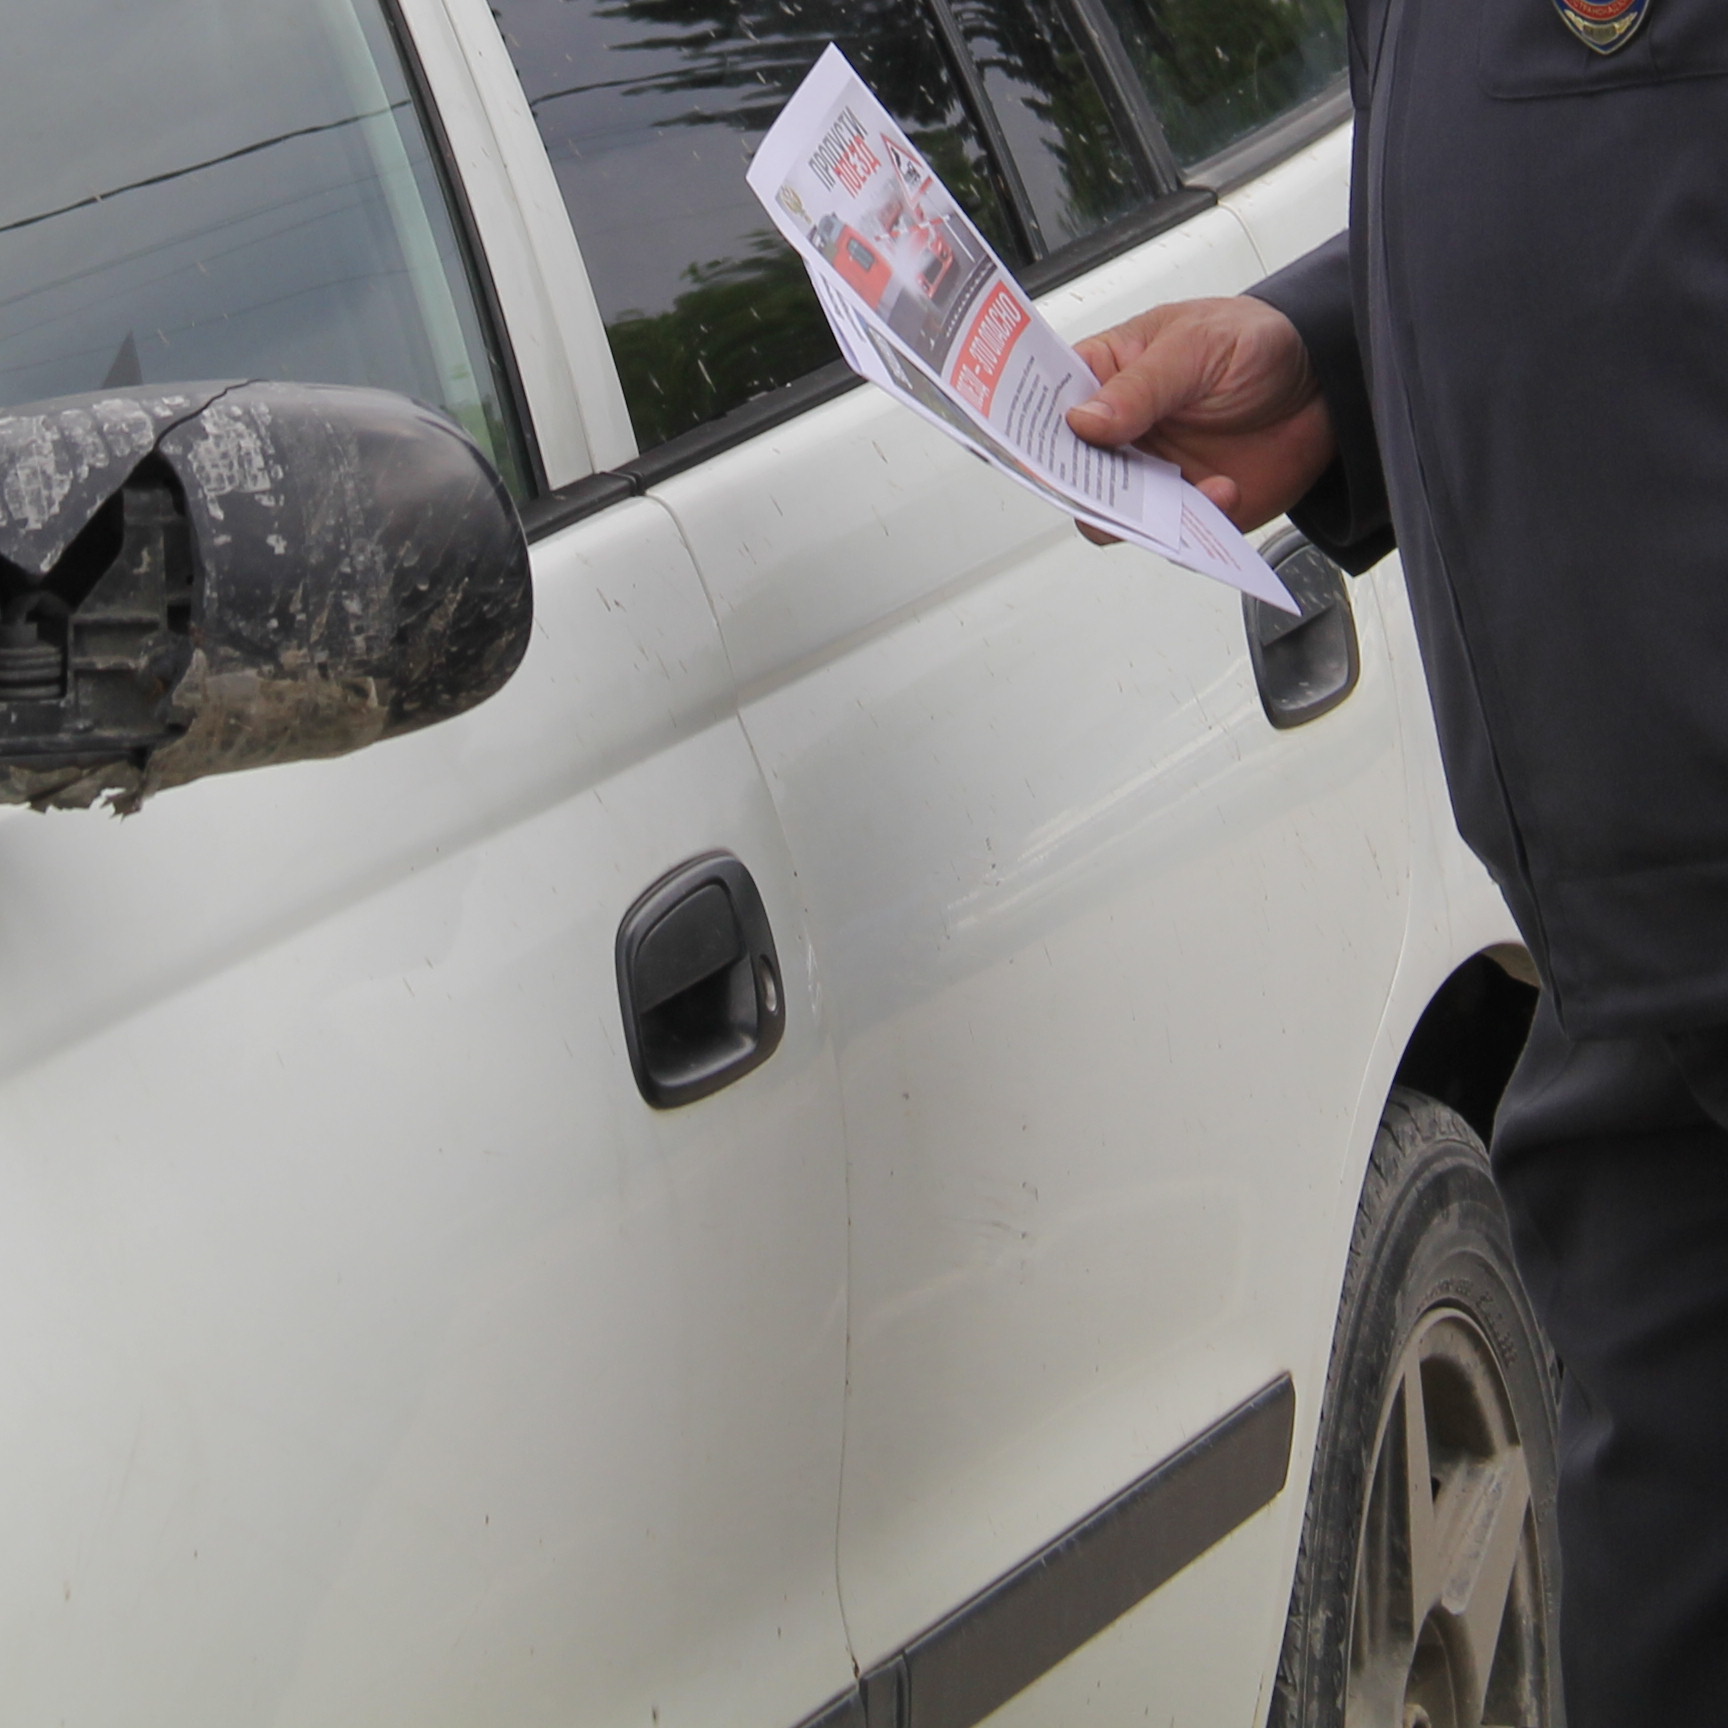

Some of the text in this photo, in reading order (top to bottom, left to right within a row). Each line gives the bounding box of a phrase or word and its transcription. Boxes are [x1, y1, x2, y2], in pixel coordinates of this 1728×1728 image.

[808, 105, 868, 192] ПРОПУСТИ
[833, 135, 882, 199] ПОЕЗД
[978, 291, 1022, 356] ОПАСНО
